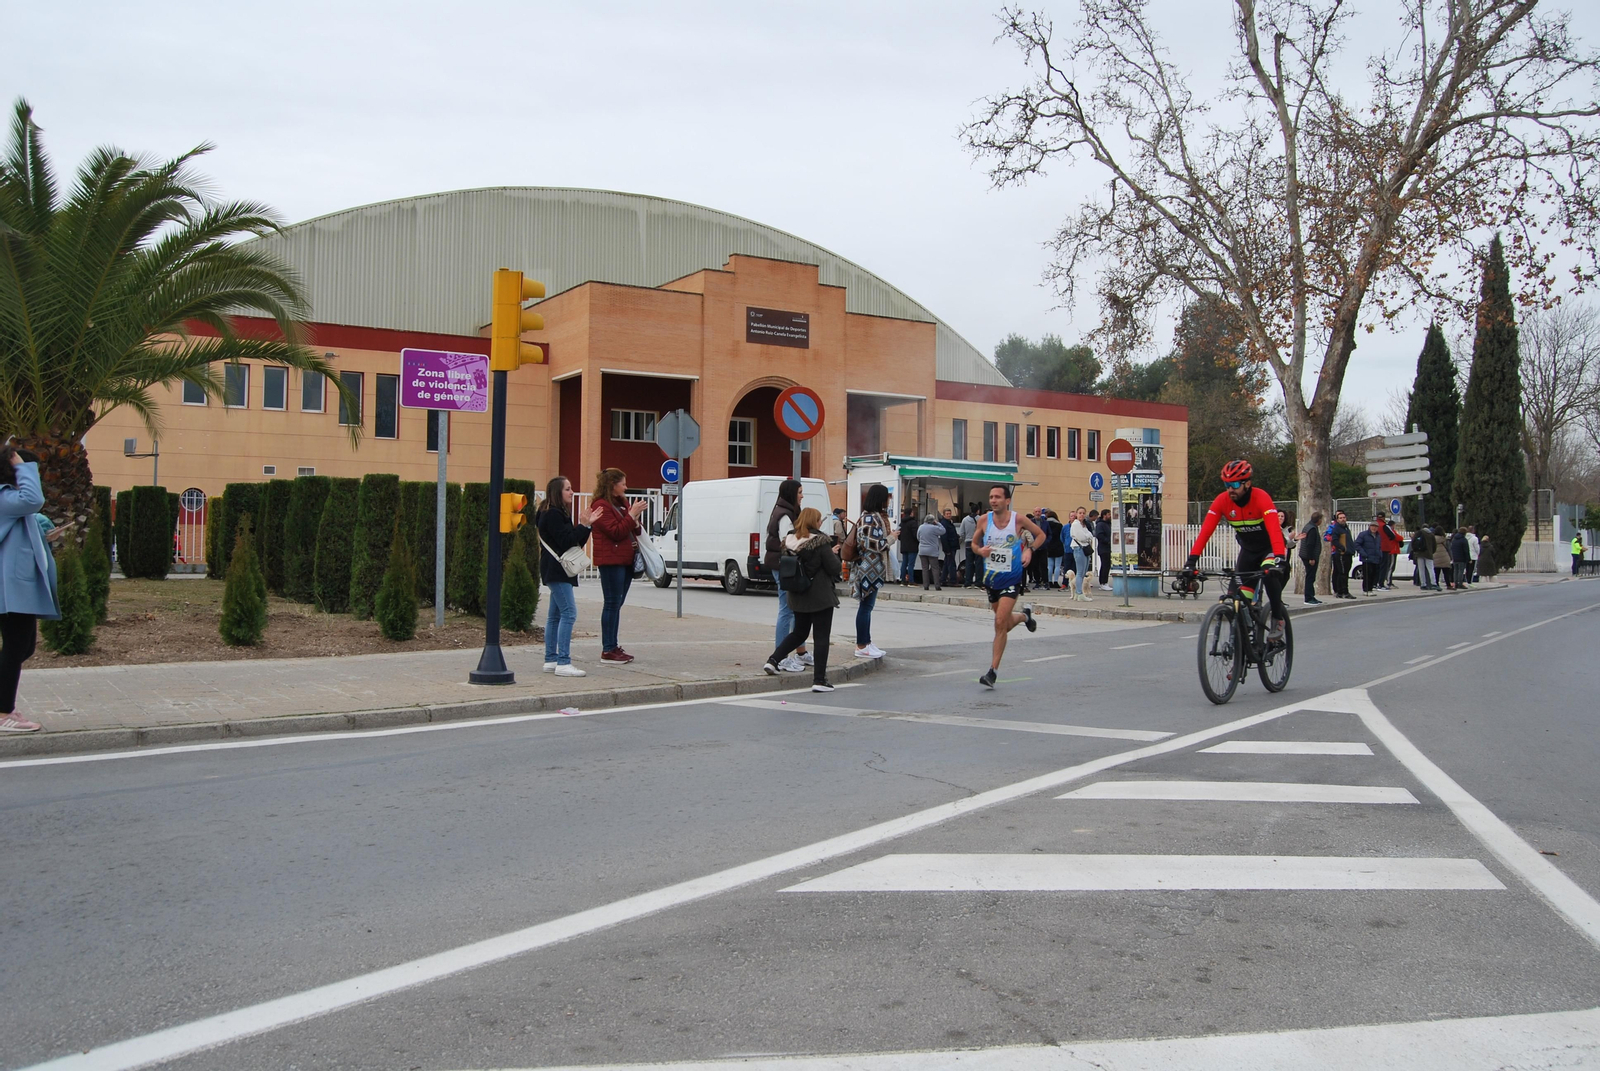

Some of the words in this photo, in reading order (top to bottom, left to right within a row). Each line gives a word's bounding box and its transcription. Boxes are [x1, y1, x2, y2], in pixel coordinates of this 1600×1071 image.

[417, 368, 445, 378] Zona
[448, 370, 472, 380] libre
[412, 379, 426, 388] de
[428, 380, 477, 391] violencia
[417, 390, 431, 399] de
[434, 390, 471, 402] género
[990, 552, 1007, 563] 925
